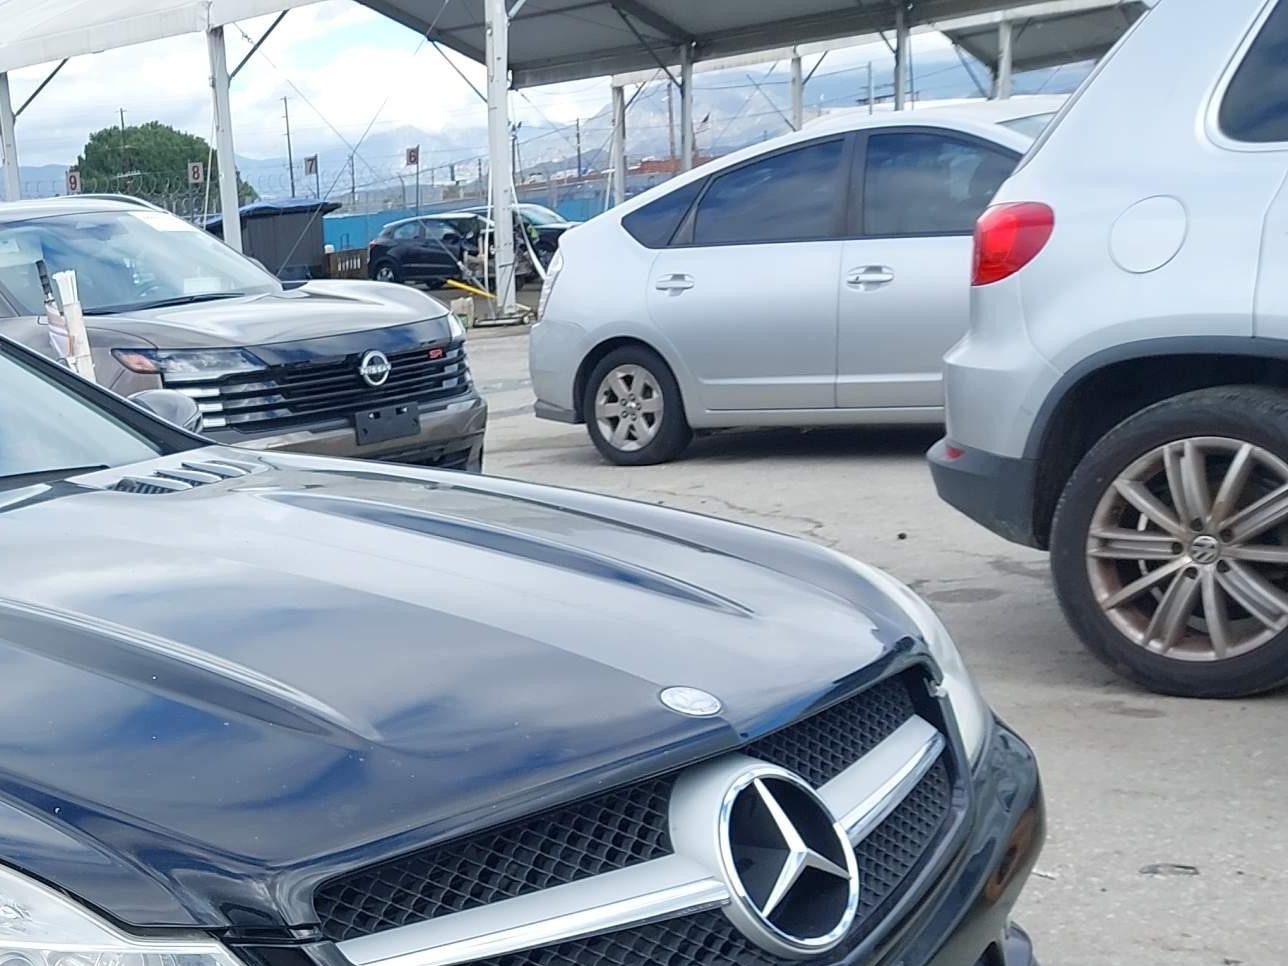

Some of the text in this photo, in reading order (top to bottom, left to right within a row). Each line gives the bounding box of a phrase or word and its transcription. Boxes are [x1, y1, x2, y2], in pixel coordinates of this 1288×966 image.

[409, 150, 417, 163] 6
[192, 165, 200, 180] 8
[307, 158, 314, 173] 7
[69, 175, 77, 191] 9
